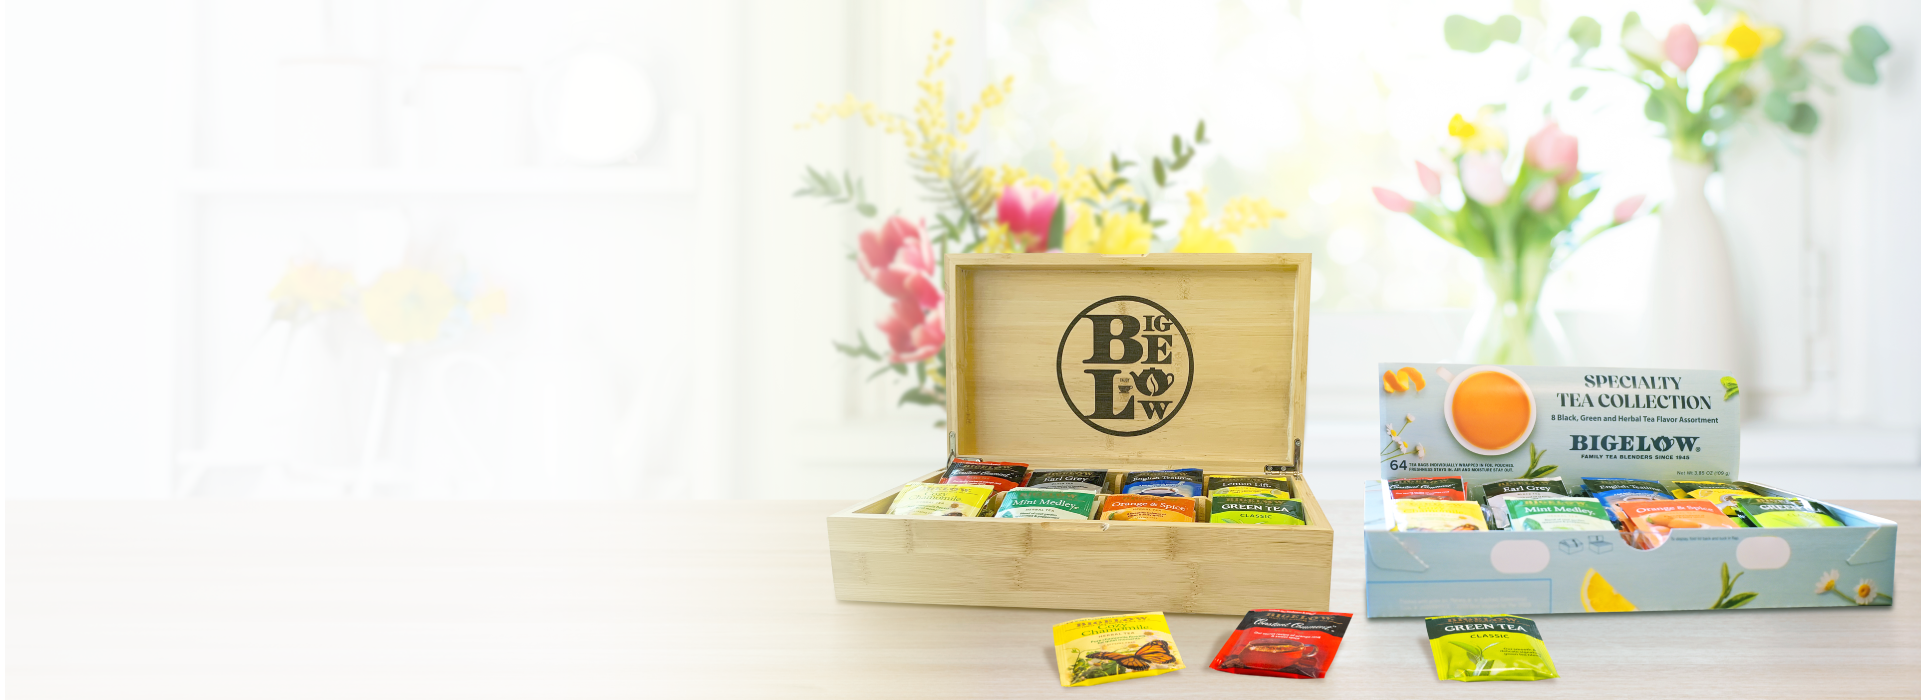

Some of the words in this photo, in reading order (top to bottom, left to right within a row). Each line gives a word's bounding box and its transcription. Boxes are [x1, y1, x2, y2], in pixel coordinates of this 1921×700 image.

[1584, 374, 1682, 390] SPECIALTY
[1556, 392, 1594, 408] TEA
[1598, 394, 1712, 410] COLLECTION
[1390, 460, 1407, 470] 64
[1160, 503, 1185, 511] Spice
[1554, 506, 1596, 515] Medley
[1076, 616, 1149, 627] BIGELOW
[1266, 613, 1334, 621] BIGELOW
[1081, 625, 1149, 636] Chamomile
[1496, 624, 1527, 632] TEA
